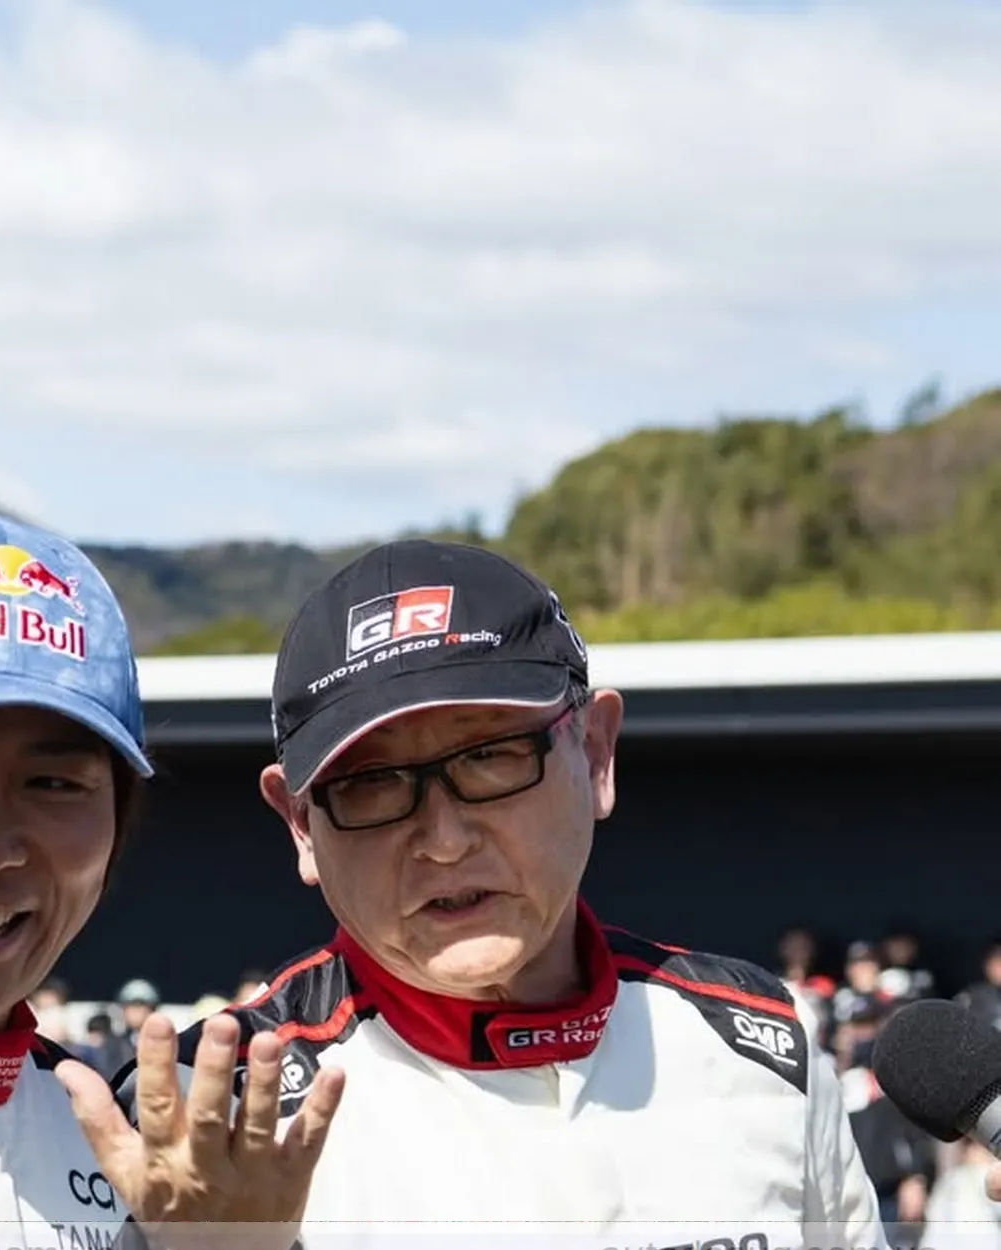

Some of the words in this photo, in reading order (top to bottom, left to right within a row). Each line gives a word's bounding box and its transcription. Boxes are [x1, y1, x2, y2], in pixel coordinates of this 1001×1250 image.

[20, 609, 86, 658] Bull
[351, 603, 447, 651] GR
[308, 659, 368, 694] TOYOTA
[374, 638, 440, 664] GAZOO
[444, 629, 502, 646] Racing
[508, 1029, 556, 1048] GR
[561, 1004, 612, 1031] GAZ
[734, 1014, 798, 1056] OMP
